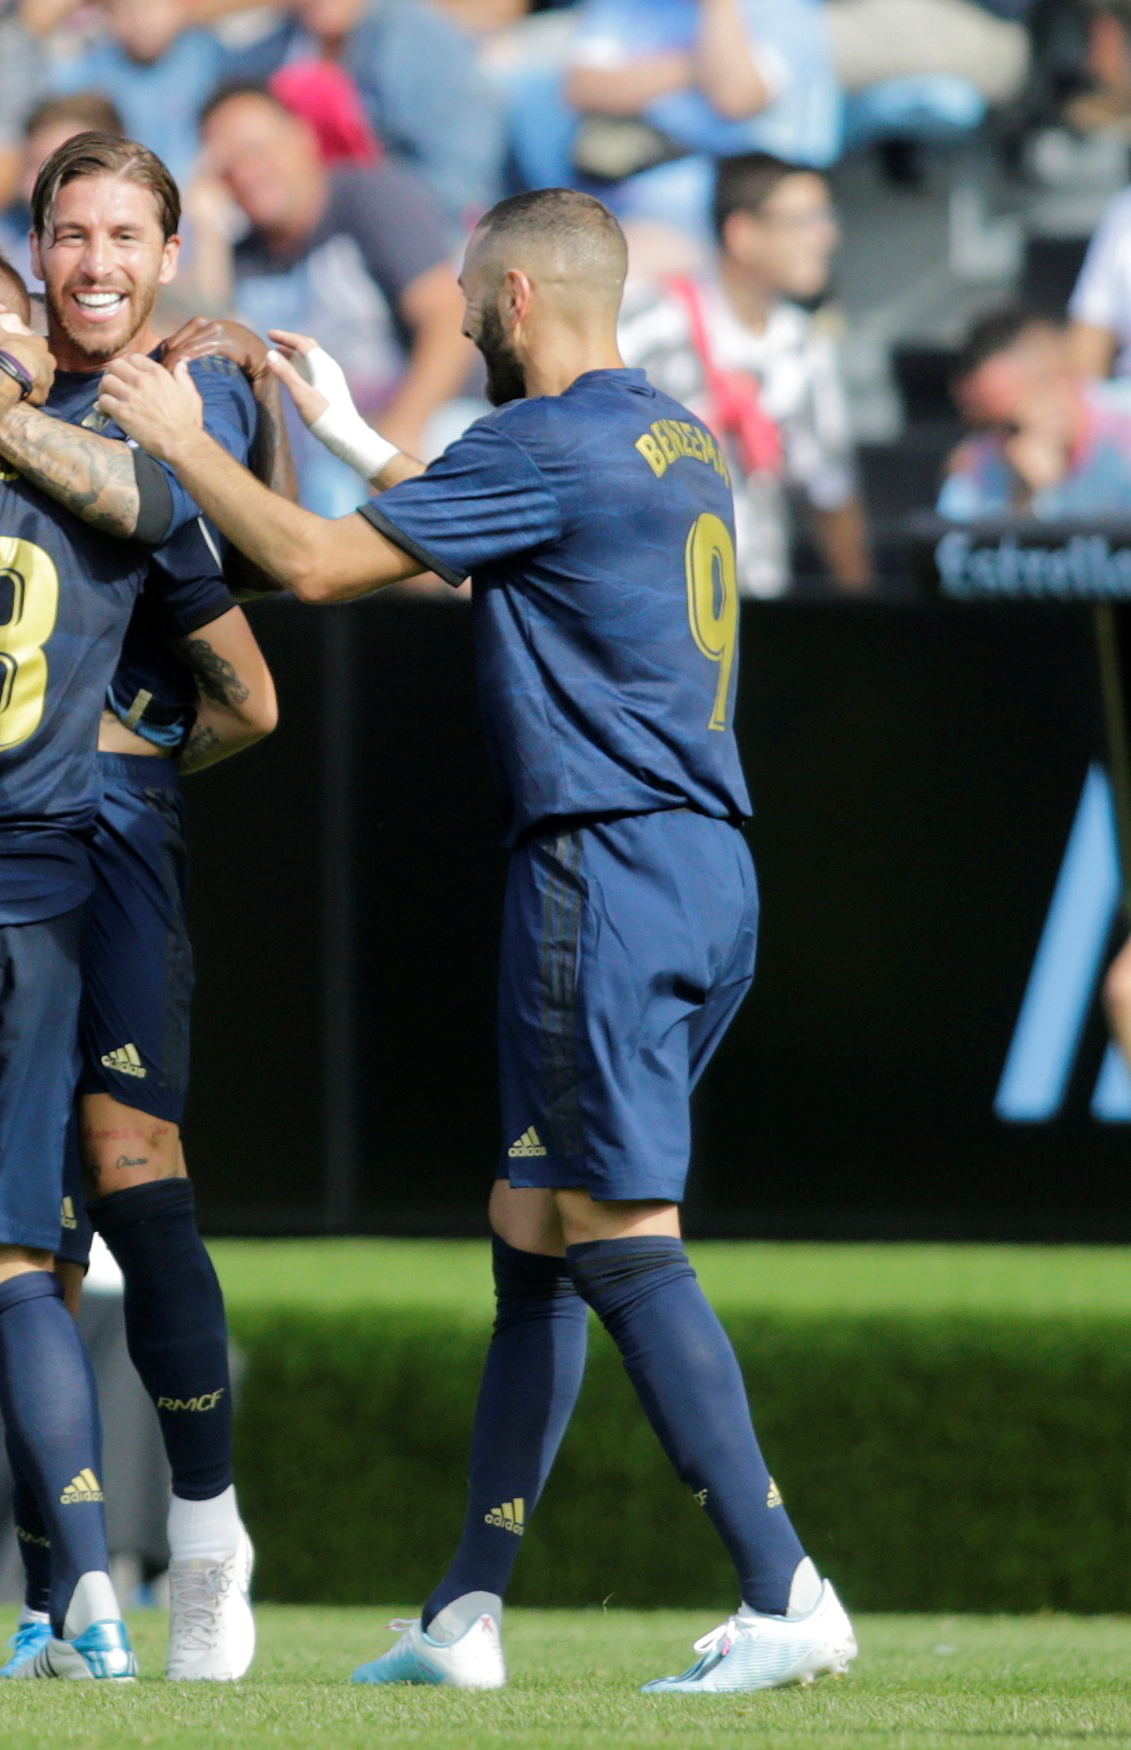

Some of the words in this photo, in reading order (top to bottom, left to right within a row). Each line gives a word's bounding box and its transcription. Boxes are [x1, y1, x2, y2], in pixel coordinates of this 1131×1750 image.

[684, 512, 737, 731] 9
[101, 1055, 147, 1078] adidas
[508, 1146, 547, 1157] adidas
[157, 1387, 225, 1411] RMCF
[60, 1491, 103, 1504] adidas
[484, 1513, 524, 1536] adidas
